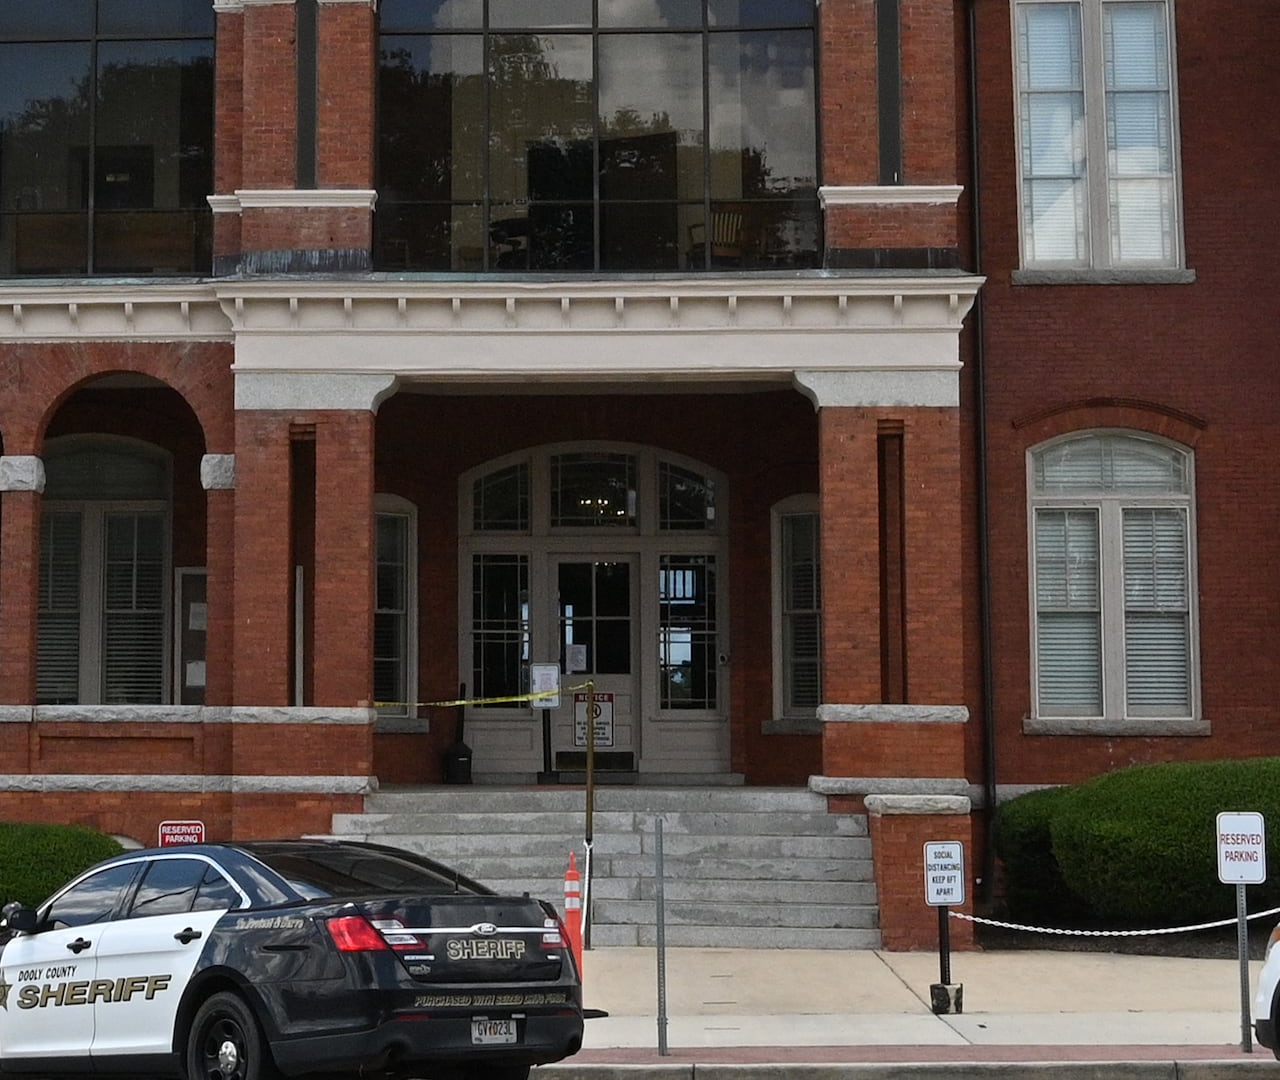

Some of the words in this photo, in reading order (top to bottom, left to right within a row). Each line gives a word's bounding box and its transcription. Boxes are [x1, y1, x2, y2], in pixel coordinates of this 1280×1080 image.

[161, 825, 202, 834] RESERVED
[165, 835, 198, 843] PARKING
[1220, 834, 1261, 845] RESERVED
[933, 850, 953, 859] SOCIAL
[1225, 851, 1258, 862] PARKING
[928, 863, 961, 872] DISTANCING
[932, 875, 945, 884] KEEP
[936, 888, 954, 896] APART
[447, 939, 526, 961] SHERIFF
[18, 968, 43, 982] DOOLY
[45, 965, 77, 978] COUNTY
[17, 973, 172, 1010] SHERIFF
